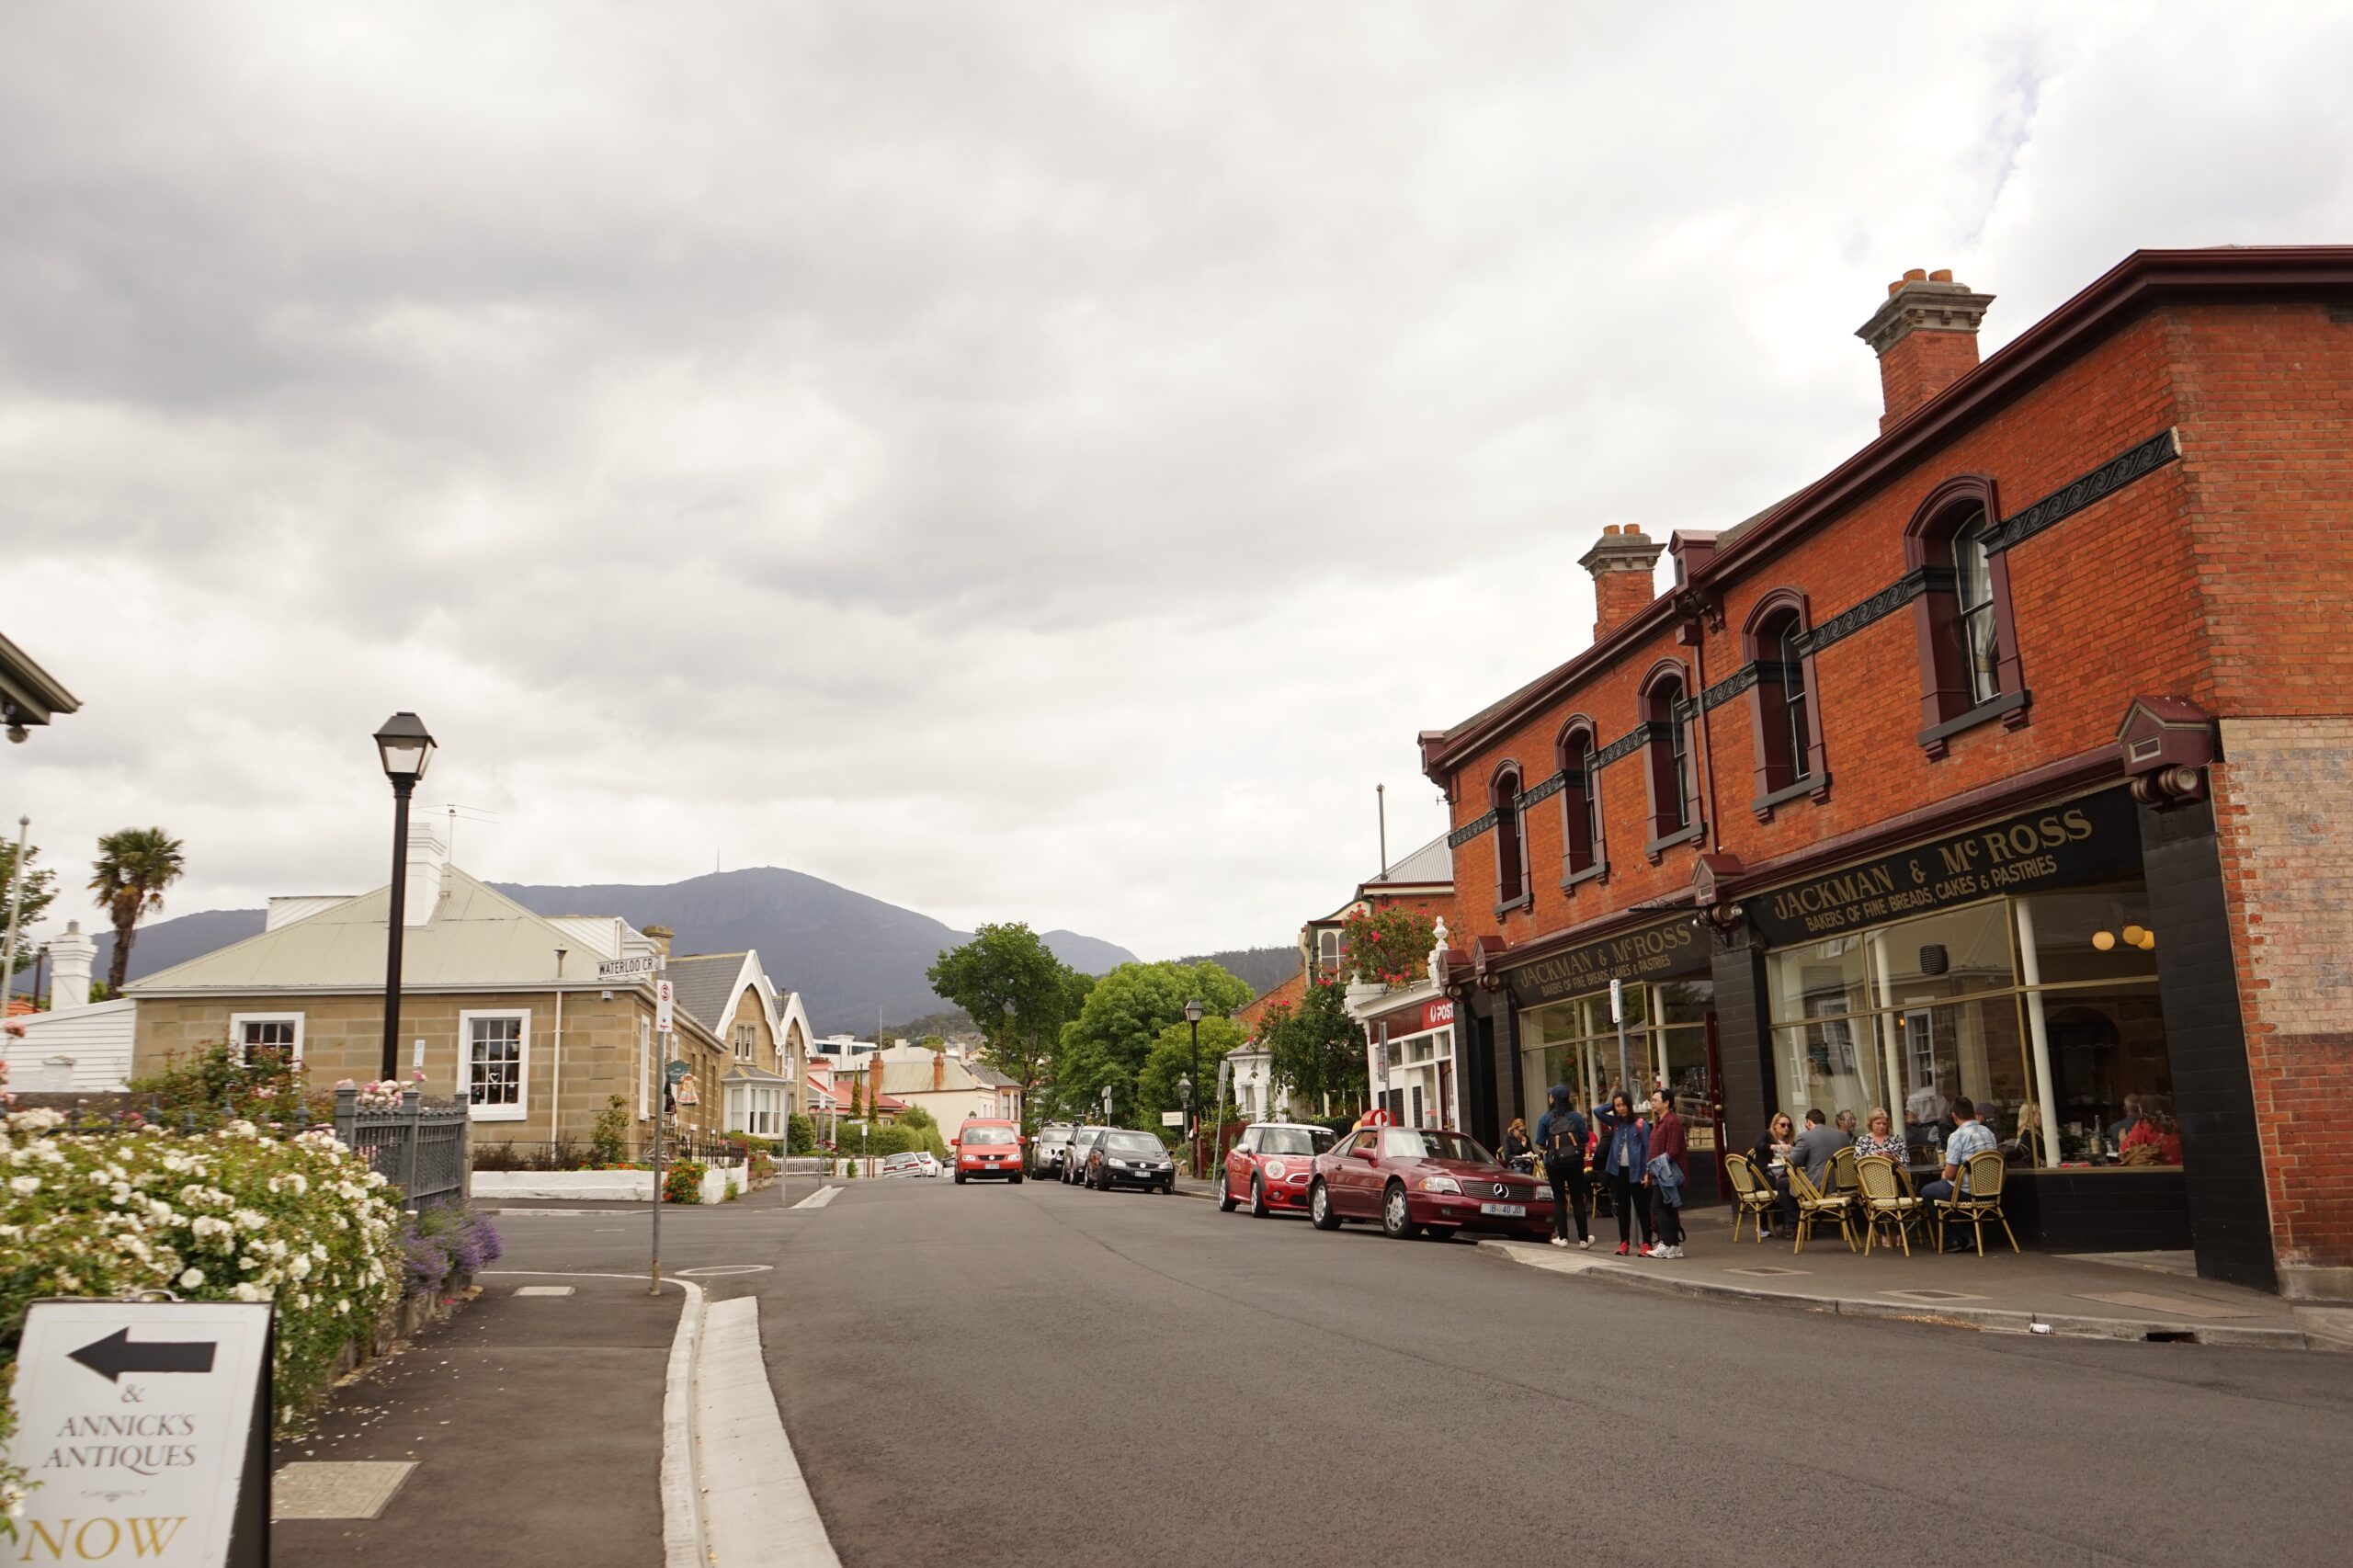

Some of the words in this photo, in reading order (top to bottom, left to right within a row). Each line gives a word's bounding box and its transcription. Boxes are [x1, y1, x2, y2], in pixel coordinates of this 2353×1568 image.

[1775, 865, 1894, 920] JACKMAN
[1909, 859, 1927, 883] &
[1806, 910, 1845, 932] BAKERS
[1847, 904, 1861, 923] OF
[1862, 899, 1888, 918] FINE
[1888, 887, 1938, 912] BREADS,
[1935, 876, 1977, 900] CAKES
[1980, 875, 1990, 890] &
[1990, 855, 2058, 888] PASTRIES
[599, 960, 640, 975] WATERLOO
[642, 958, 653, 971] CR
[1521, 950, 1593, 988] JACKMAN
[1597, 949, 1608, 966] &
[1540, 981, 1563, 997] BAKERS
[1563, 978, 1572, 991] OF
[1573, 975, 1586, 989] FINE
[1610, 963, 1631, 979] CAKES
[1633, 964, 1639, 974] &
[1638, 954, 1671, 972] PASTRIES
[1437, 1003, 1453, 1021] POST
[120, 1383, 145, 1403] &
[43, 1445, 197, 1475] ANTIQUES
[18, 1517, 188, 1561] NOW
